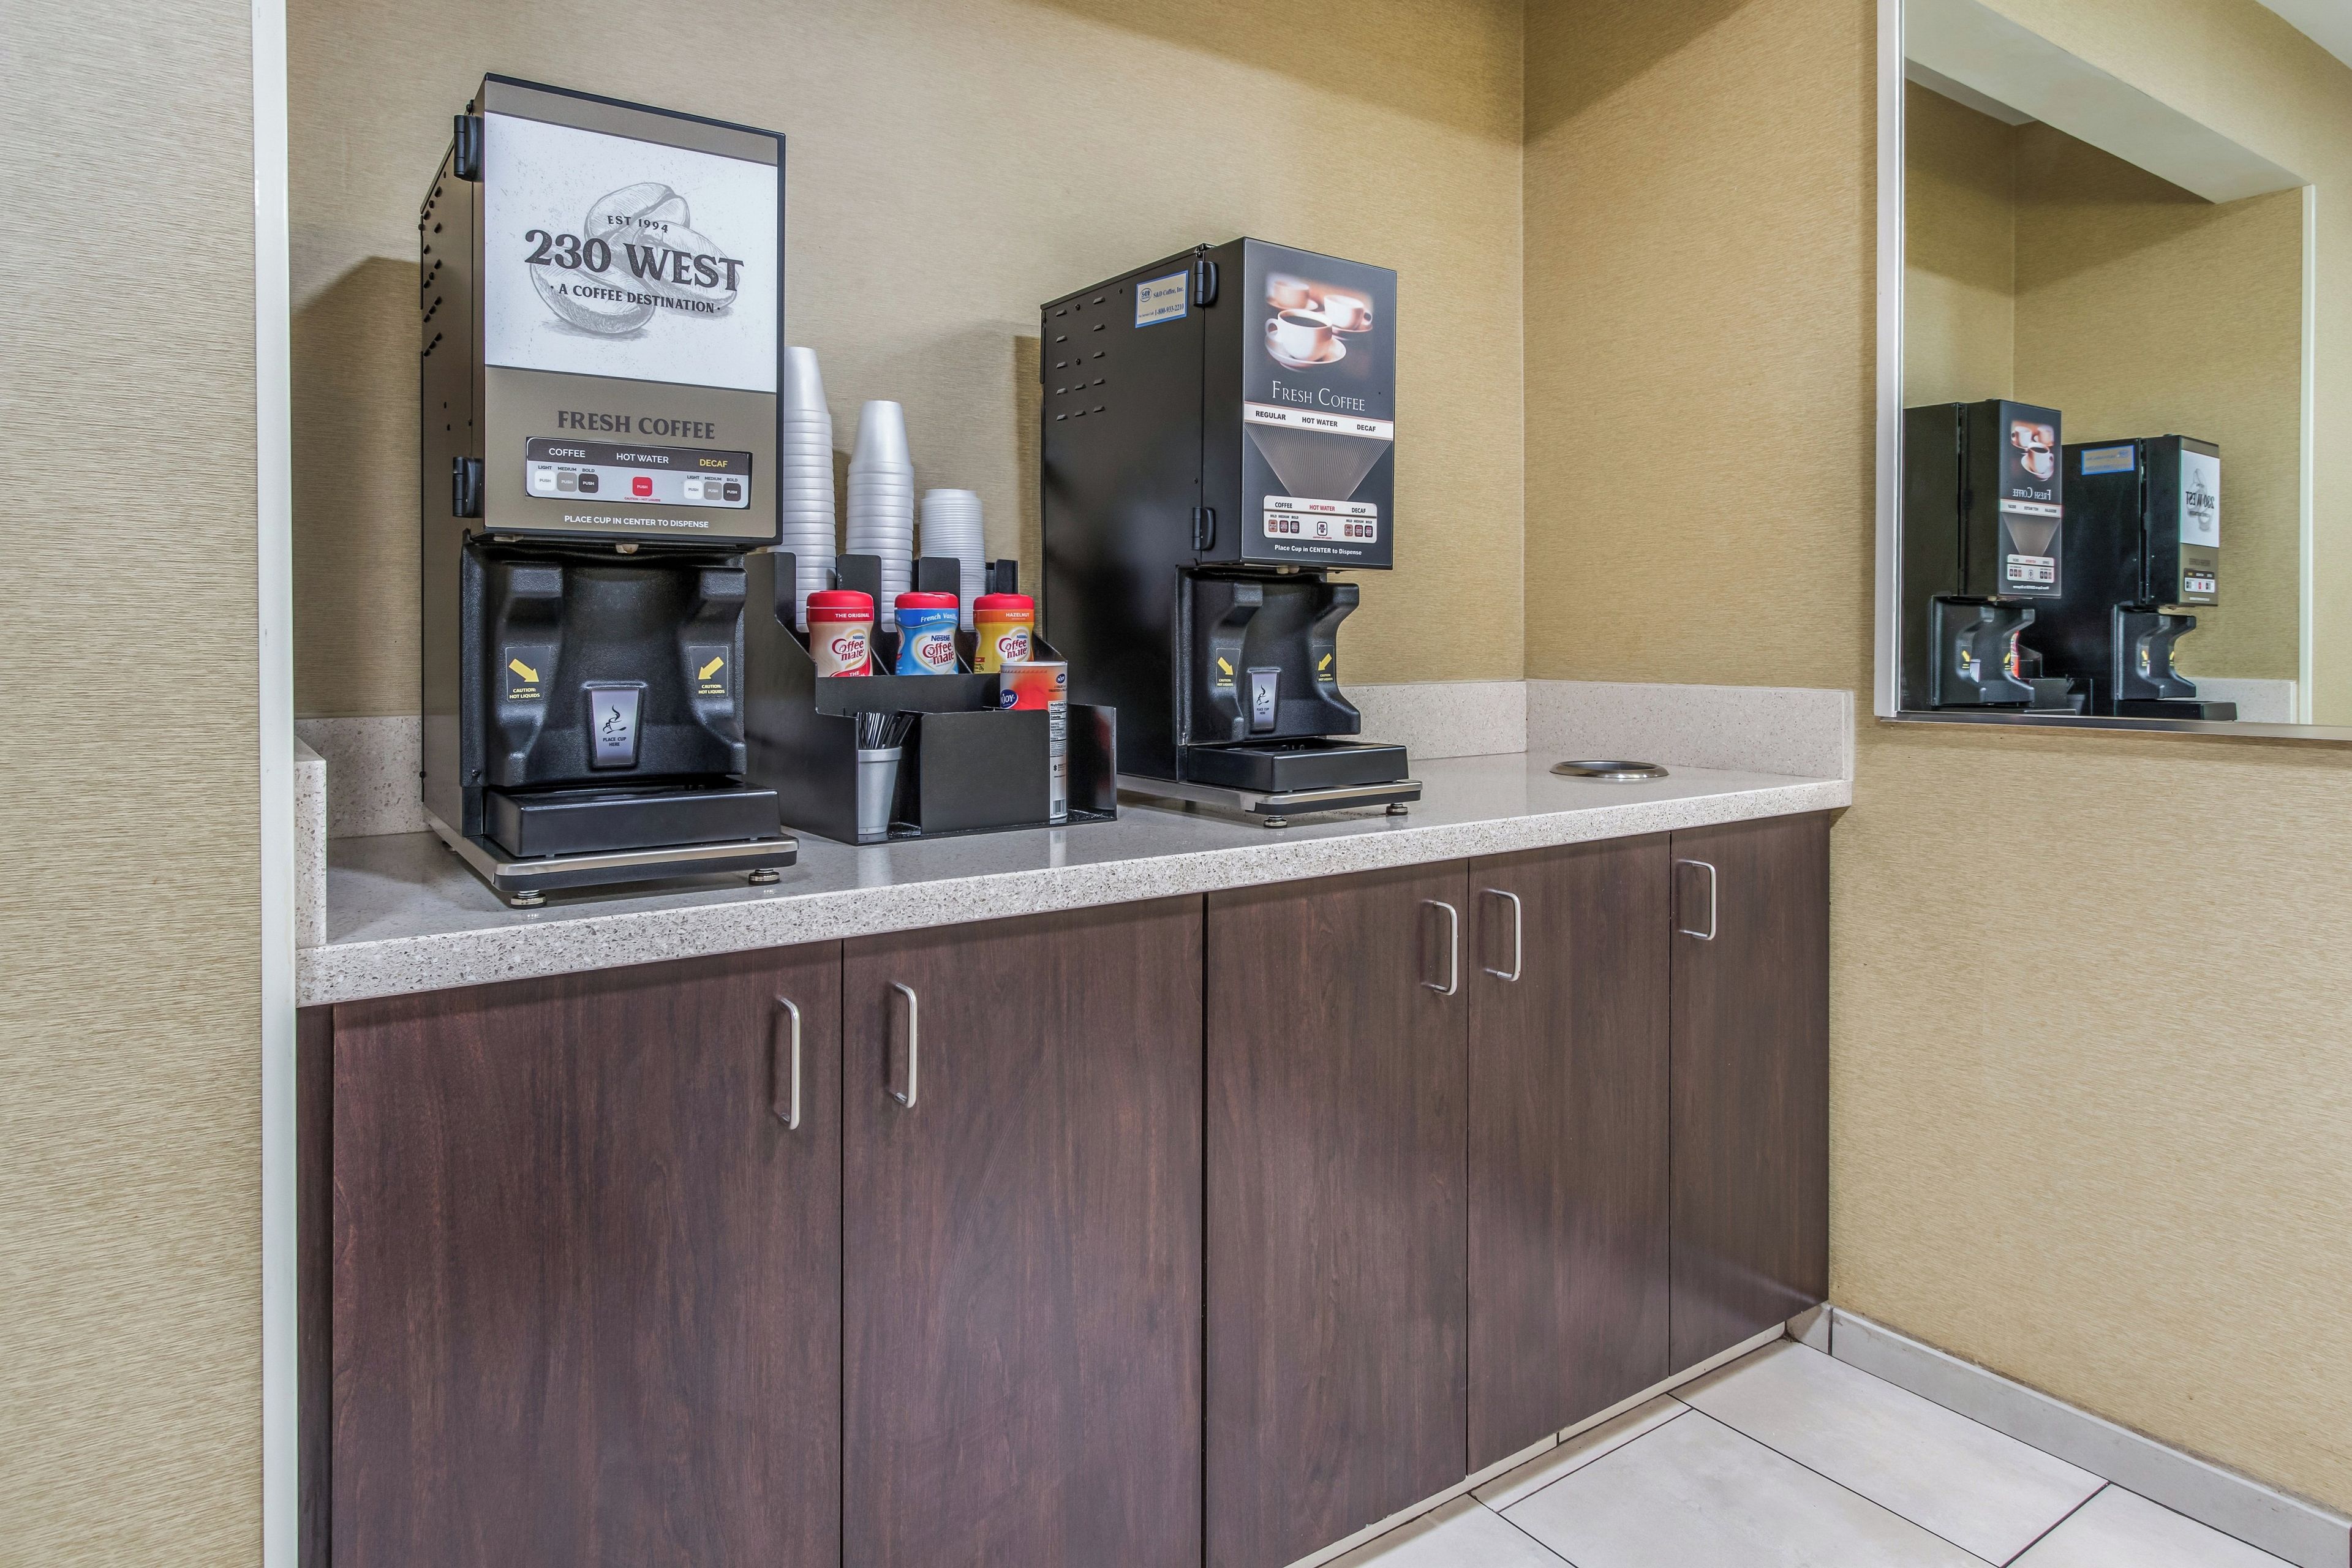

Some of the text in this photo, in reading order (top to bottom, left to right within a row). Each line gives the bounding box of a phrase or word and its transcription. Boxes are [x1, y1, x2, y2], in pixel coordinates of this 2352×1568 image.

[608, 216, 668, 233] EST 1994
[524, 229, 744, 292] 230 WEST
[559, 284, 714, 313] A COFFEE DESTINATION
[1155, 303, 1185, 316] 1-800-933-2210
[1272, 380, 1365, 411] FRESH COFFEE
[1256, 410, 1286, 420] REGULAR
[557, 410, 715, 440] FRESH COFFEE
[549, 448, 586, 458] COFFEE
[616, 453, 669, 464] HOT WATER
[699, 459, 728, 468] DECAF
[564, 515, 592, 524] PLACE
[594, 516, 611, 525] CUP
[623, 518, 657, 527] CENTER
[670, 519, 709, 529] DISPENSE
[921, 613, 941, 622] French
[832, 638, 864, 654] Coffee
[998, 638, 1027, 652] Coffee
[840, 649, 863, 661] mate
[933, 651, 954, 665] mate
[1007, 648, 1027, 658] mate
